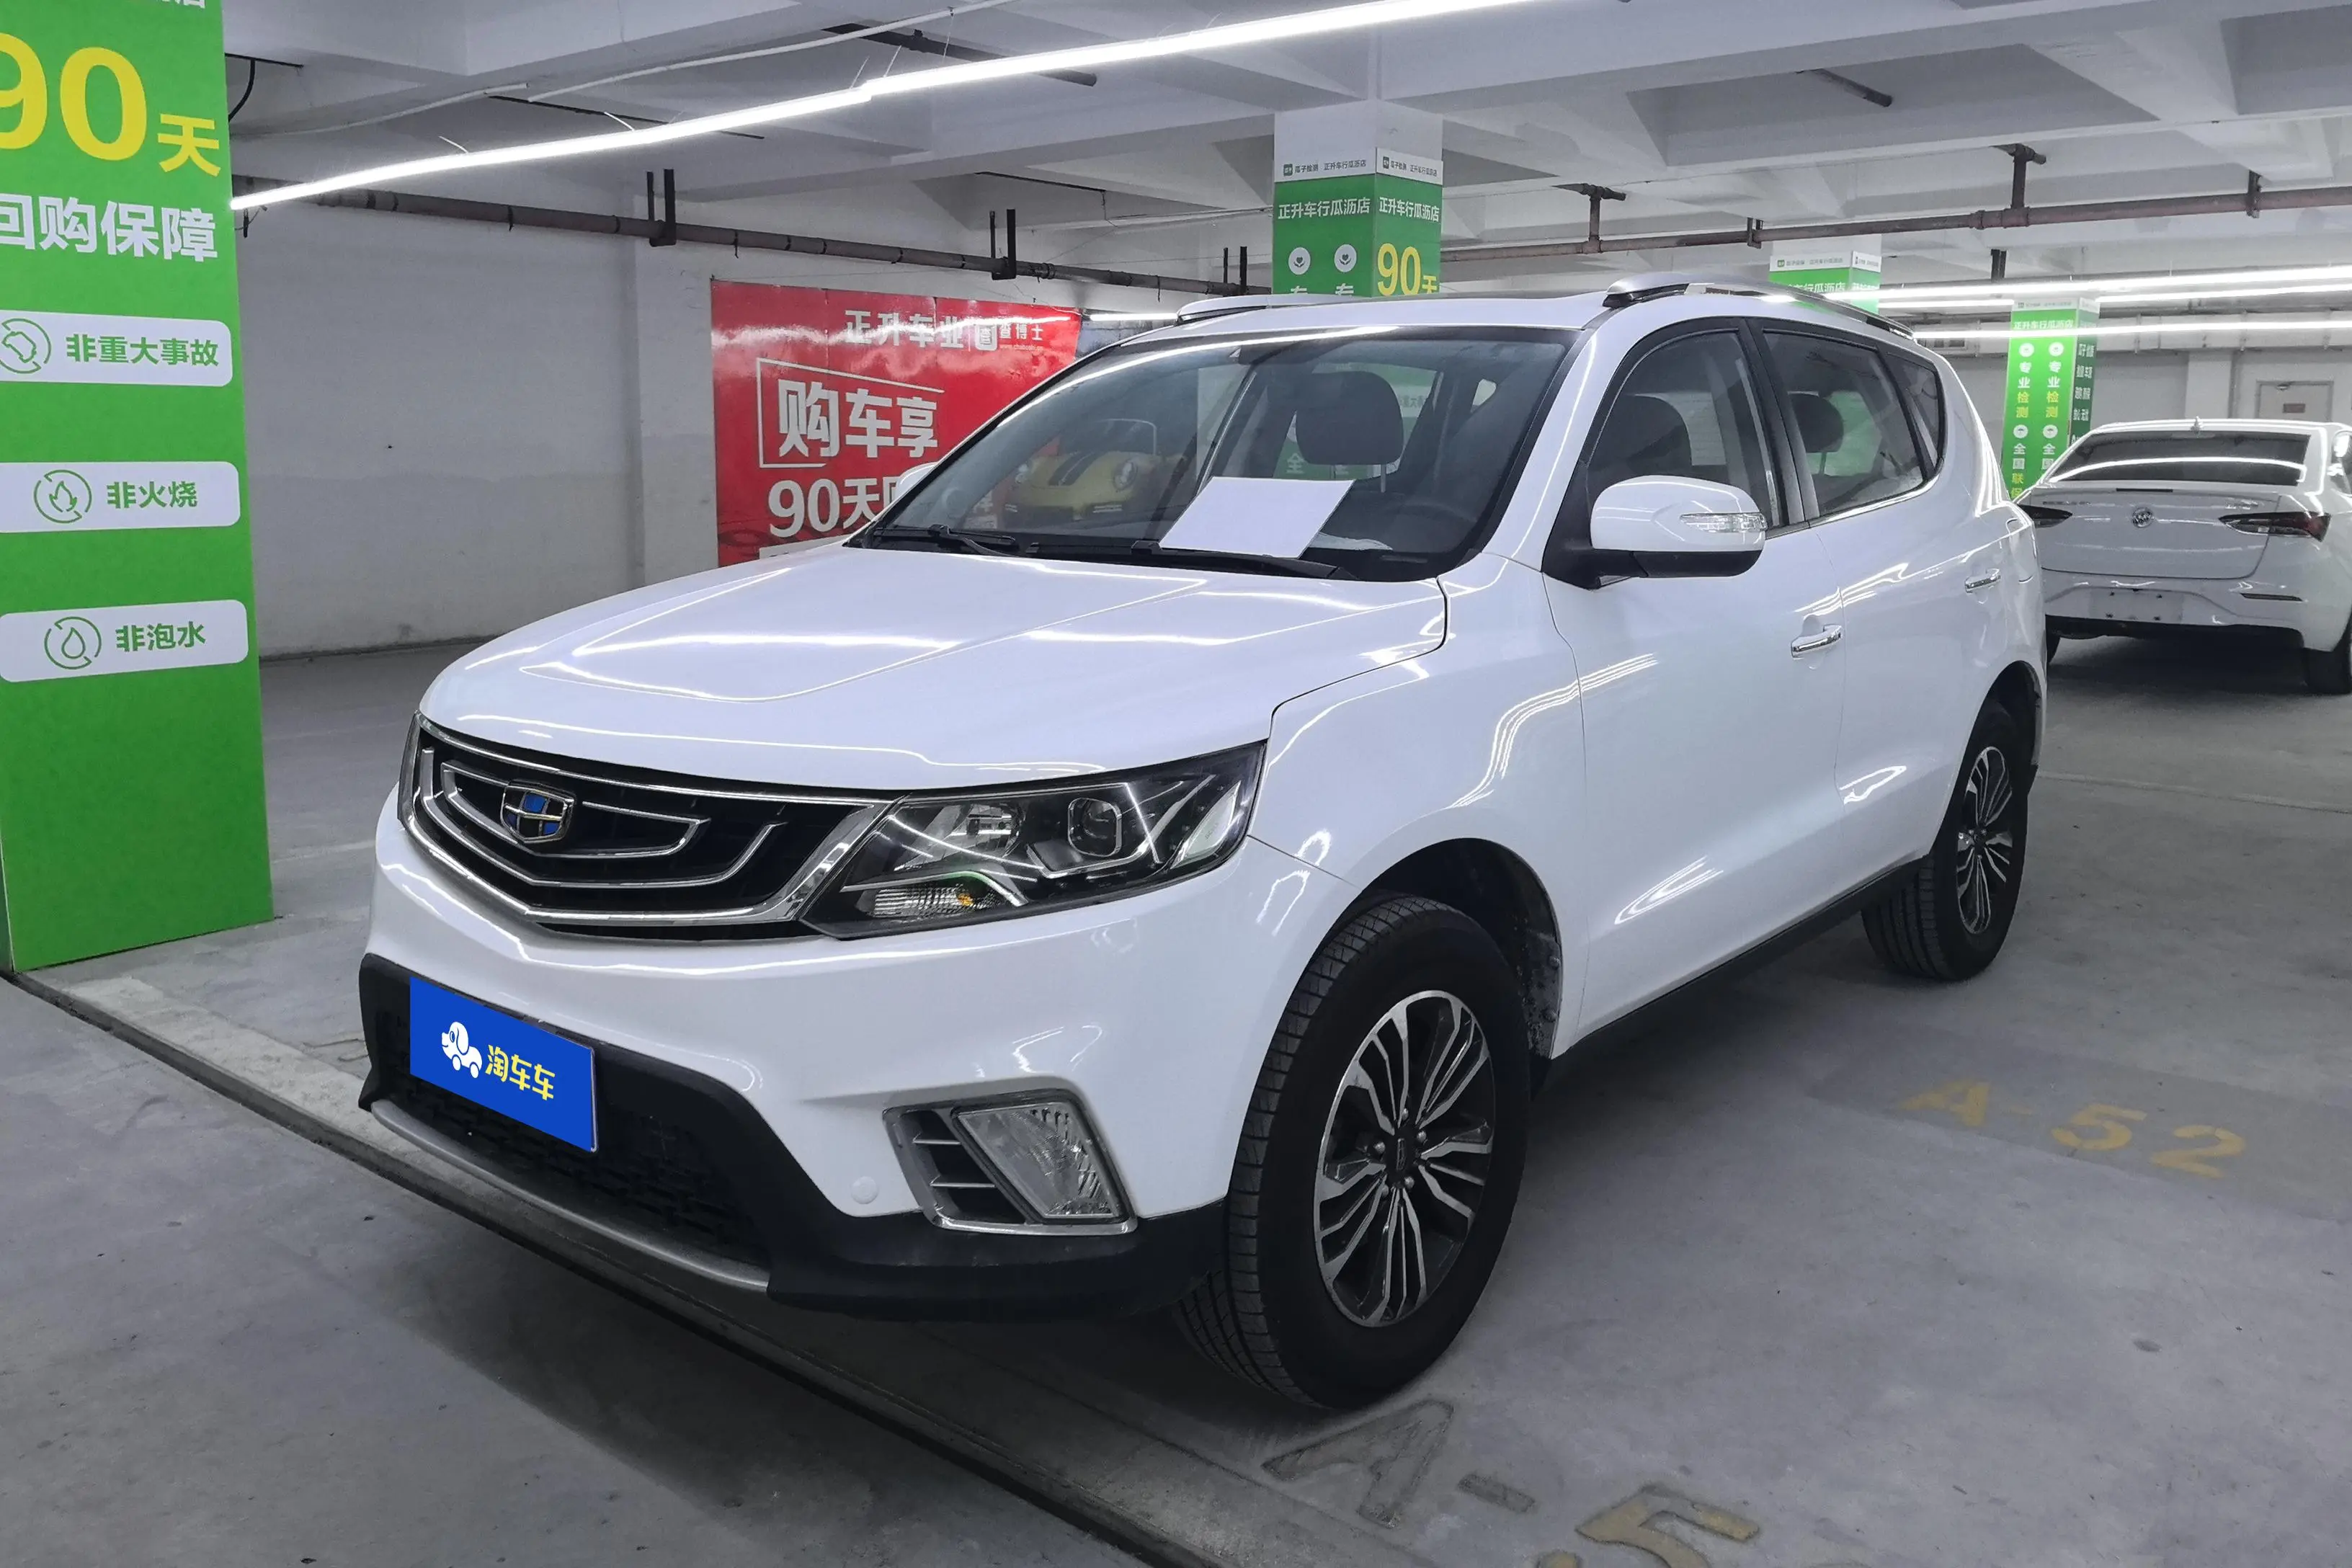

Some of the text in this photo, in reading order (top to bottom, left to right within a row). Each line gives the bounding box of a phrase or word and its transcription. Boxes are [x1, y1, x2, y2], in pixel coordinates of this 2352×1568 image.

[1278, 197, 1371, 219] 正升车行瓜沥店
[1378, 196, 1440, 222] 正升车行瓜沥店
[0, 193, 218, 262] 回购保障
[1377, 243, 1437, 296] 90天
[845, 310, 963, 348] 正升车业
[999, 322, 1043, 341] 查博士
[66, 334, 218, 366] 非重大事故
[778, 379, 937, 458] 购车享
[107, 481, 197, 508] 非火烧
[115, 622, 206, 652] 非泡水
